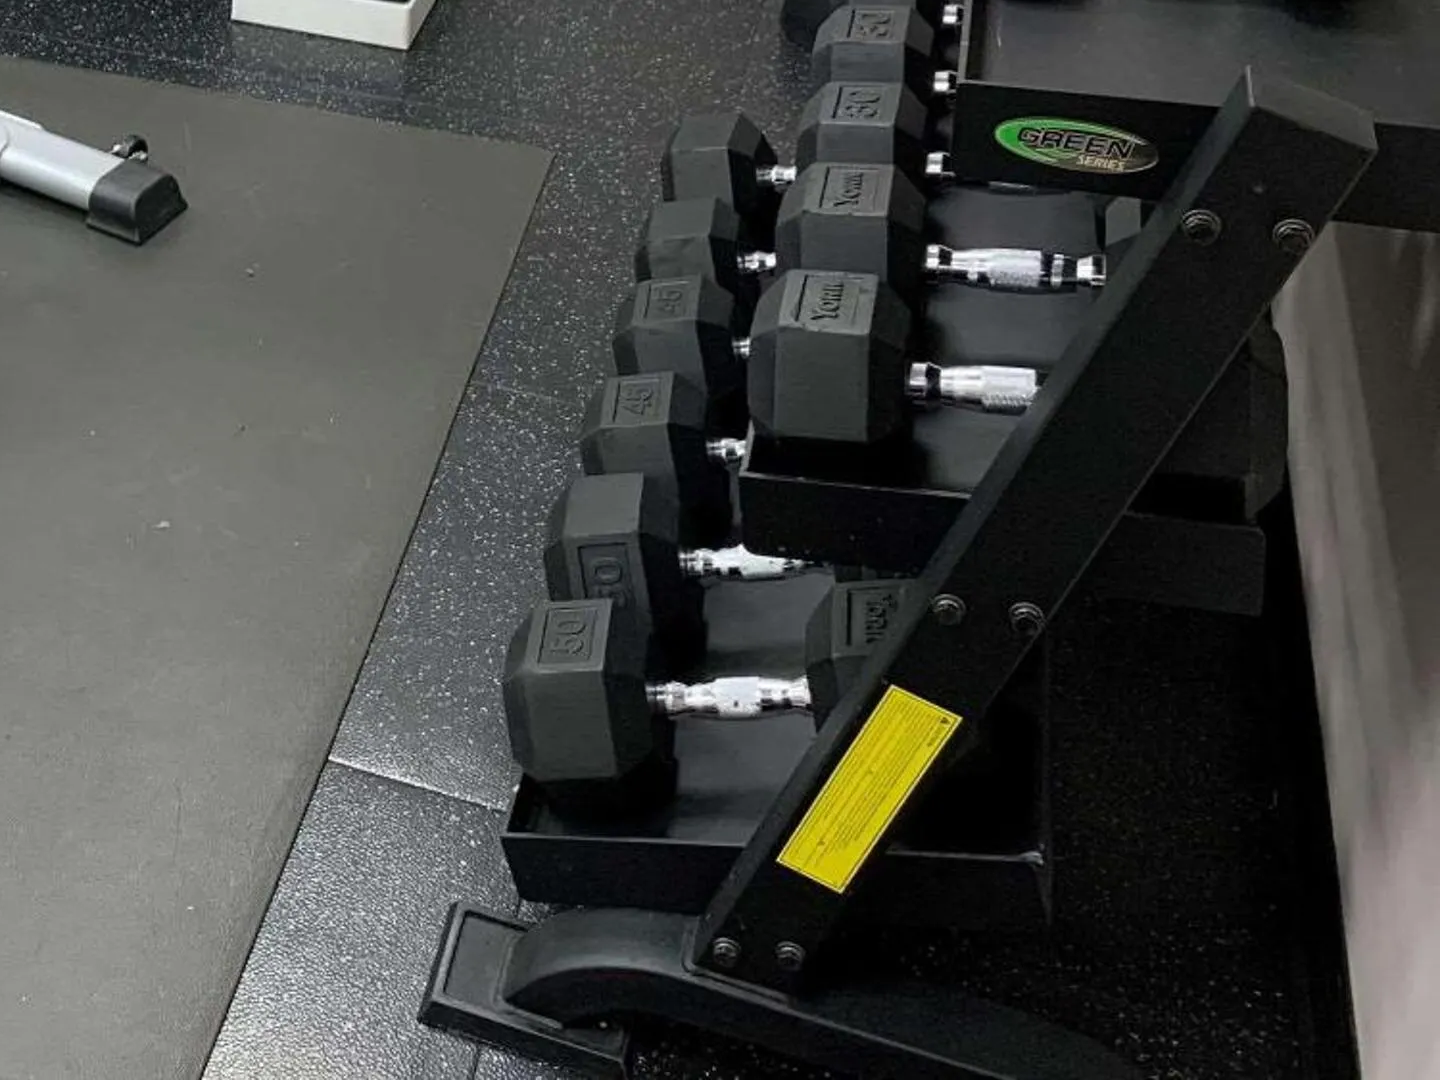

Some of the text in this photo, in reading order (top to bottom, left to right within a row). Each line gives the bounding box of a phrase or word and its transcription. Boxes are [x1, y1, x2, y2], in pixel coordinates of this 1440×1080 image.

[1017, 126, 1135, 160] GREEN
[1076, 154, 1127, 171] SERIES
[547, 619, 587, 656] 50
